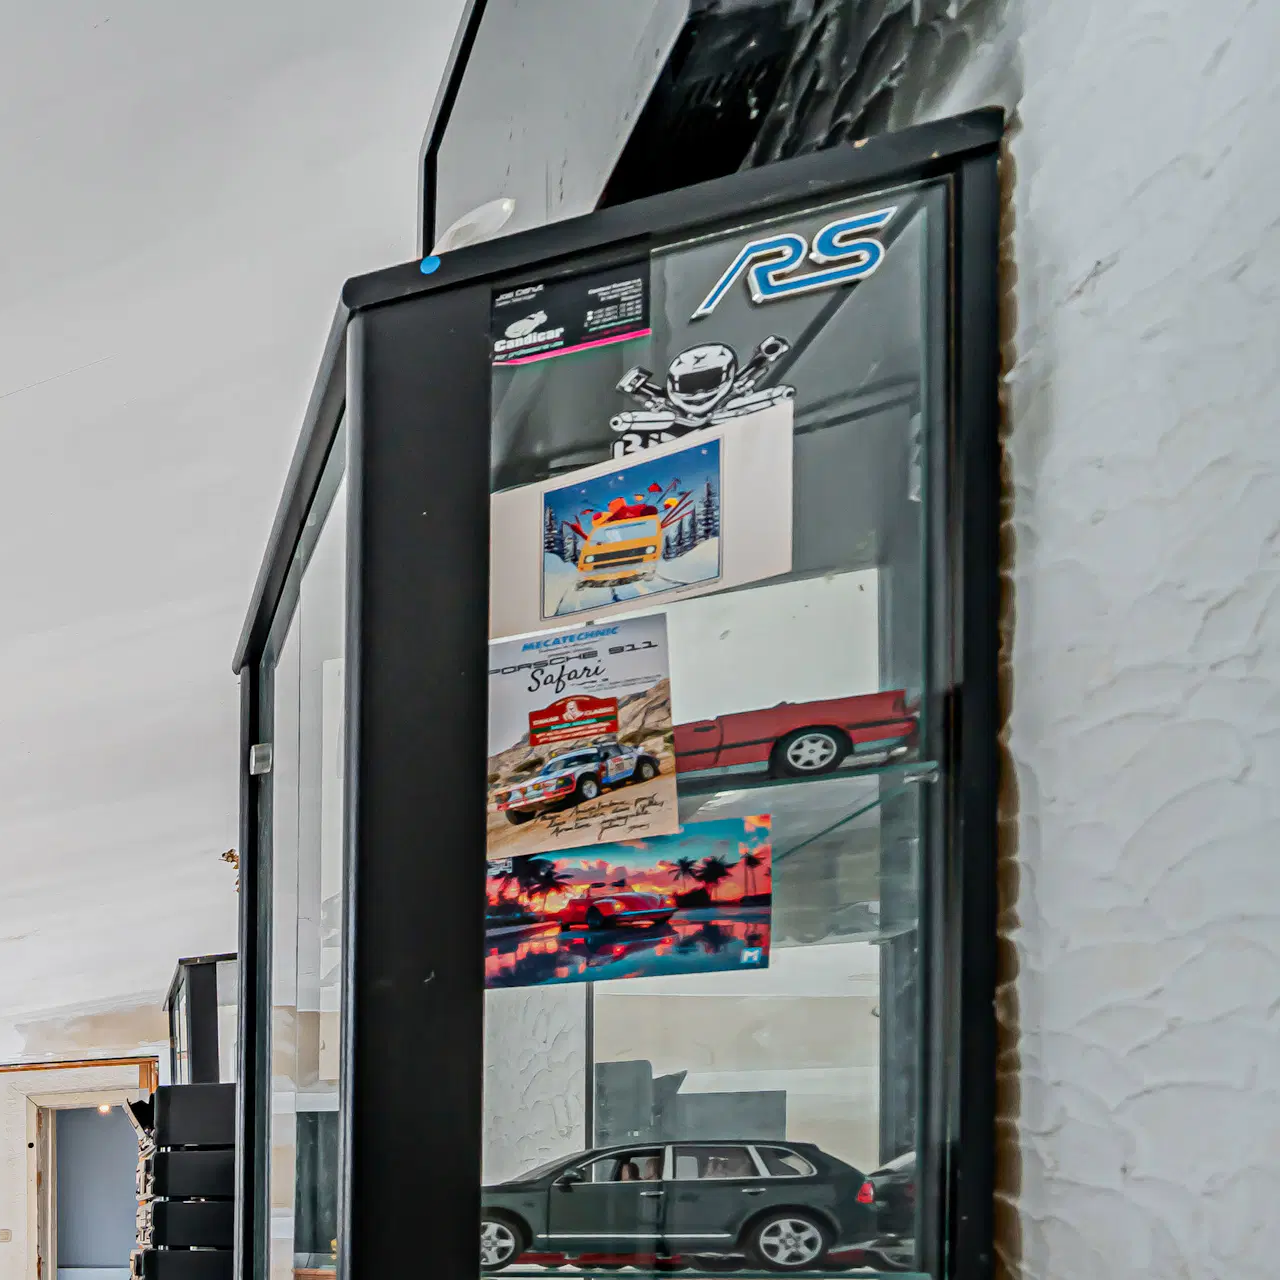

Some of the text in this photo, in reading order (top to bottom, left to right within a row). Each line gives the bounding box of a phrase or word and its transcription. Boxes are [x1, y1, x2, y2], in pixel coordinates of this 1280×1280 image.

[690, 206, 898, 323] RS
[522, 626, 620, 652] MECATECHNIC
[608, 640, 658, 655] 911
[527, 659, 607, 694] Safari
